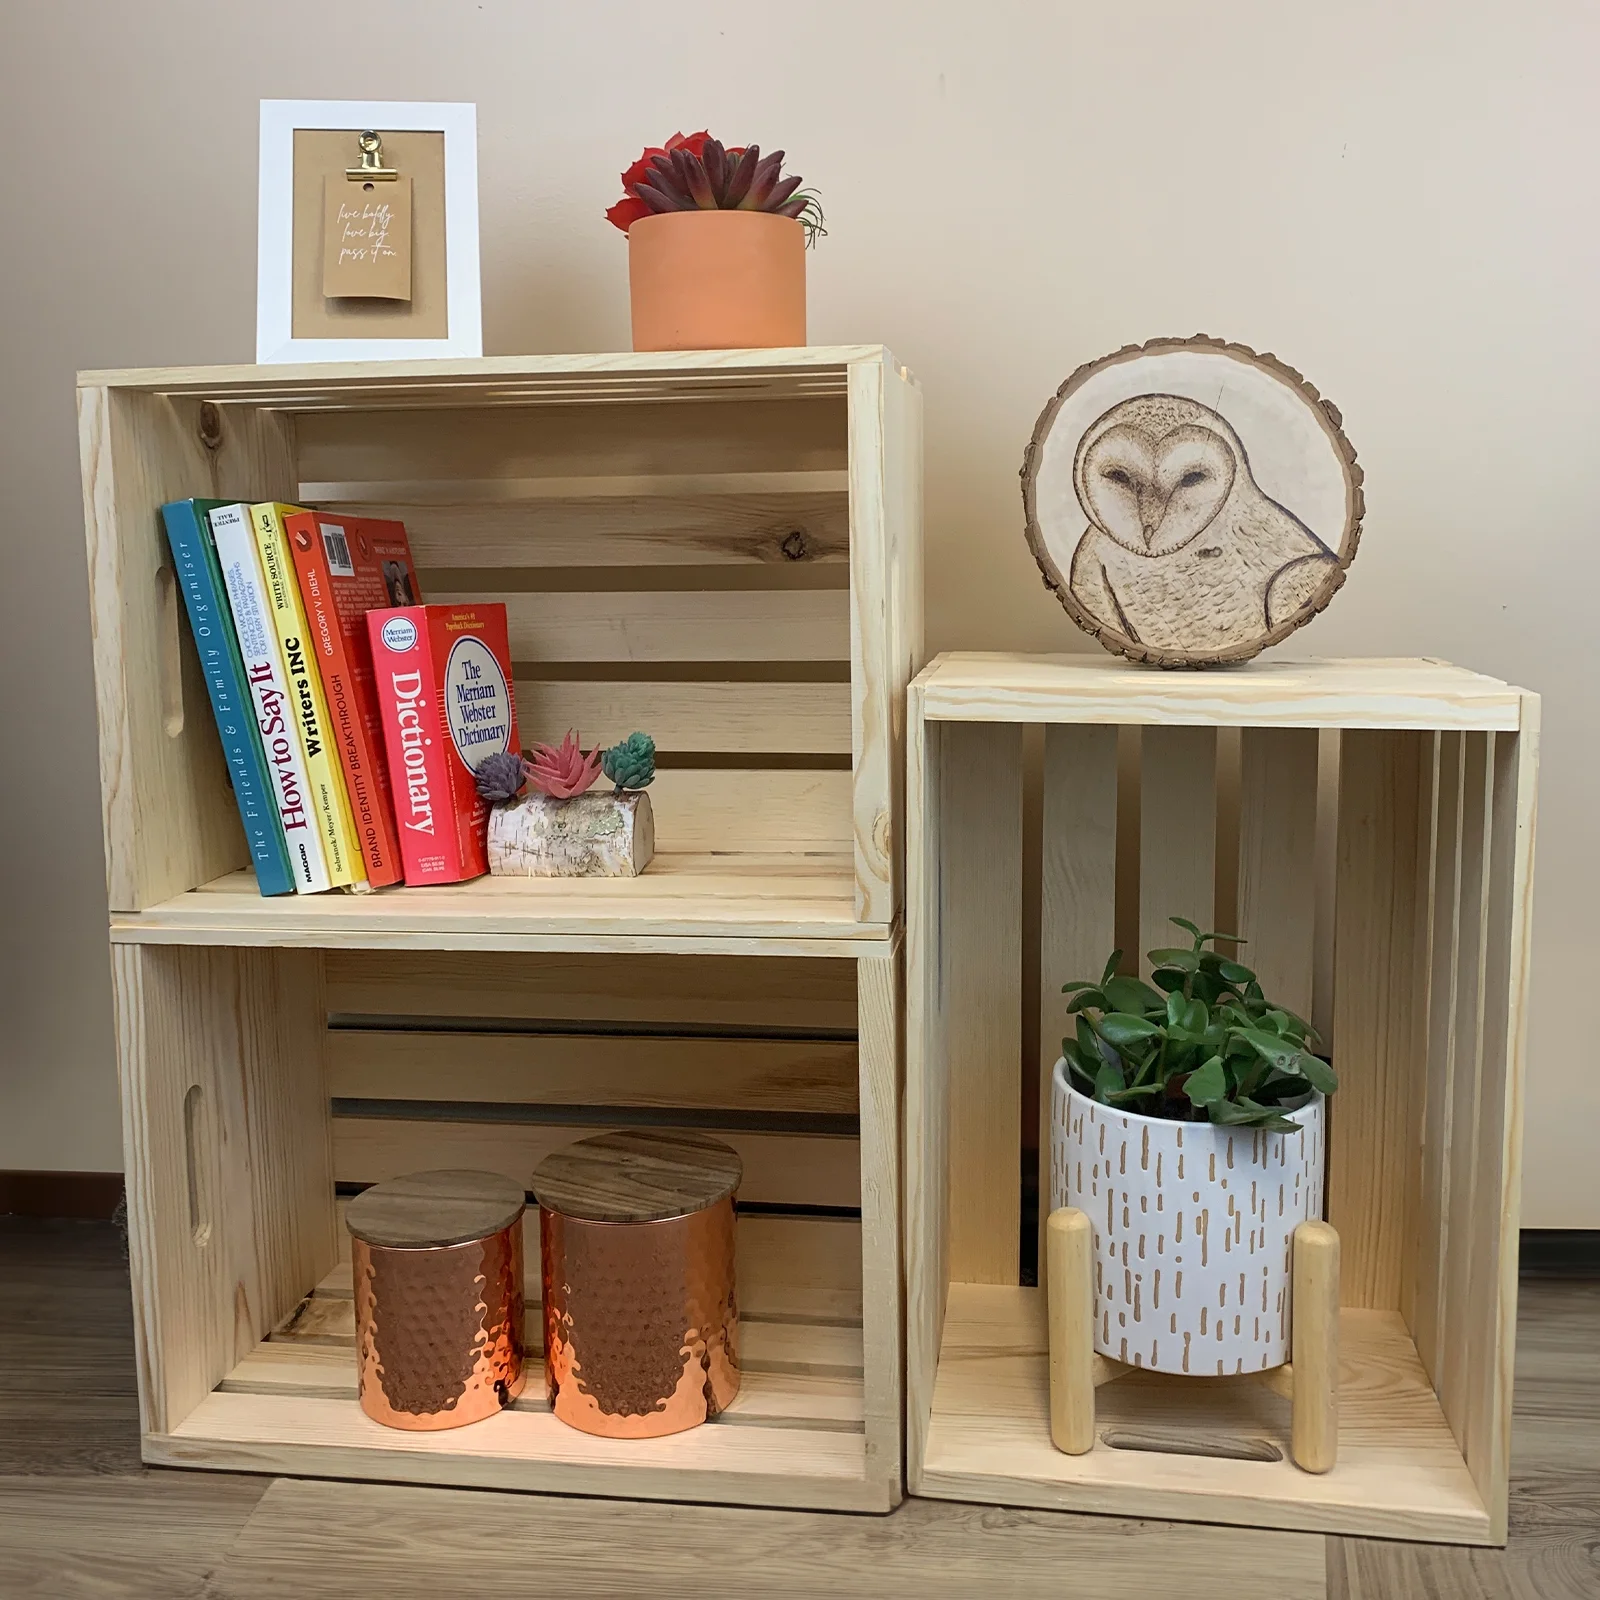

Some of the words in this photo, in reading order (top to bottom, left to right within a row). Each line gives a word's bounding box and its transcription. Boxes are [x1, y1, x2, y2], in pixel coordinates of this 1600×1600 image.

[337, 203, 360, 224] live
[341, 222, 367, 243] love
[338, 248, 368, 265] pass
[371, 244, 391, 264] it
[264, 542, 278, 580] SOURCE
[179, 542, 211, 637] Organiser
[234, 562, 250, 609] PARAGRAPHS
[272, 580, 285, 610] WRITE
[307, 568, 320, 597] DIEHL
[246, 581, 259, 616] SITUATION
[313, 597, 322, 608] V.
[246, 616, 260, 656] SENTENCES
[254, 618, 265, 638] EVERY
[315, 608, 334, 656] GREGORY
[386, 627, 413, 636] Merriam
[387, 635, 413, 643] Webster
[242, 630, 253, 658] CHOICE
[260, 640, 268, 656] FOR
[285, 637, 306, 675] INC
[207, 650, 231, 712] Family
[249, 661, 276, 687] It
[462, 659, 482, 680] The
[456, 681, 496, 703] Merriam
[259, 686, 286, 736] Say
[296, 679, 322, 758] Writers
[331, 674, 361, 771] BREAKTHROUGH
[460, 704, 497, 724] Webster
[225, 725, 236, 735] &
[458, 724, 506, 748] Dictionary
[272, 738, 292, 767] to
[391, 668, 435, 836] Dictionary
[232, 747, 259, 818] Friends
[278, 768, 308, 833] How
[352, 773, 373, 825] IDENTITY
[255, 830, 270, 860] The
[366, 828, 383, 869] BRAND
[298, 843, 313, 883] MAGGIO
